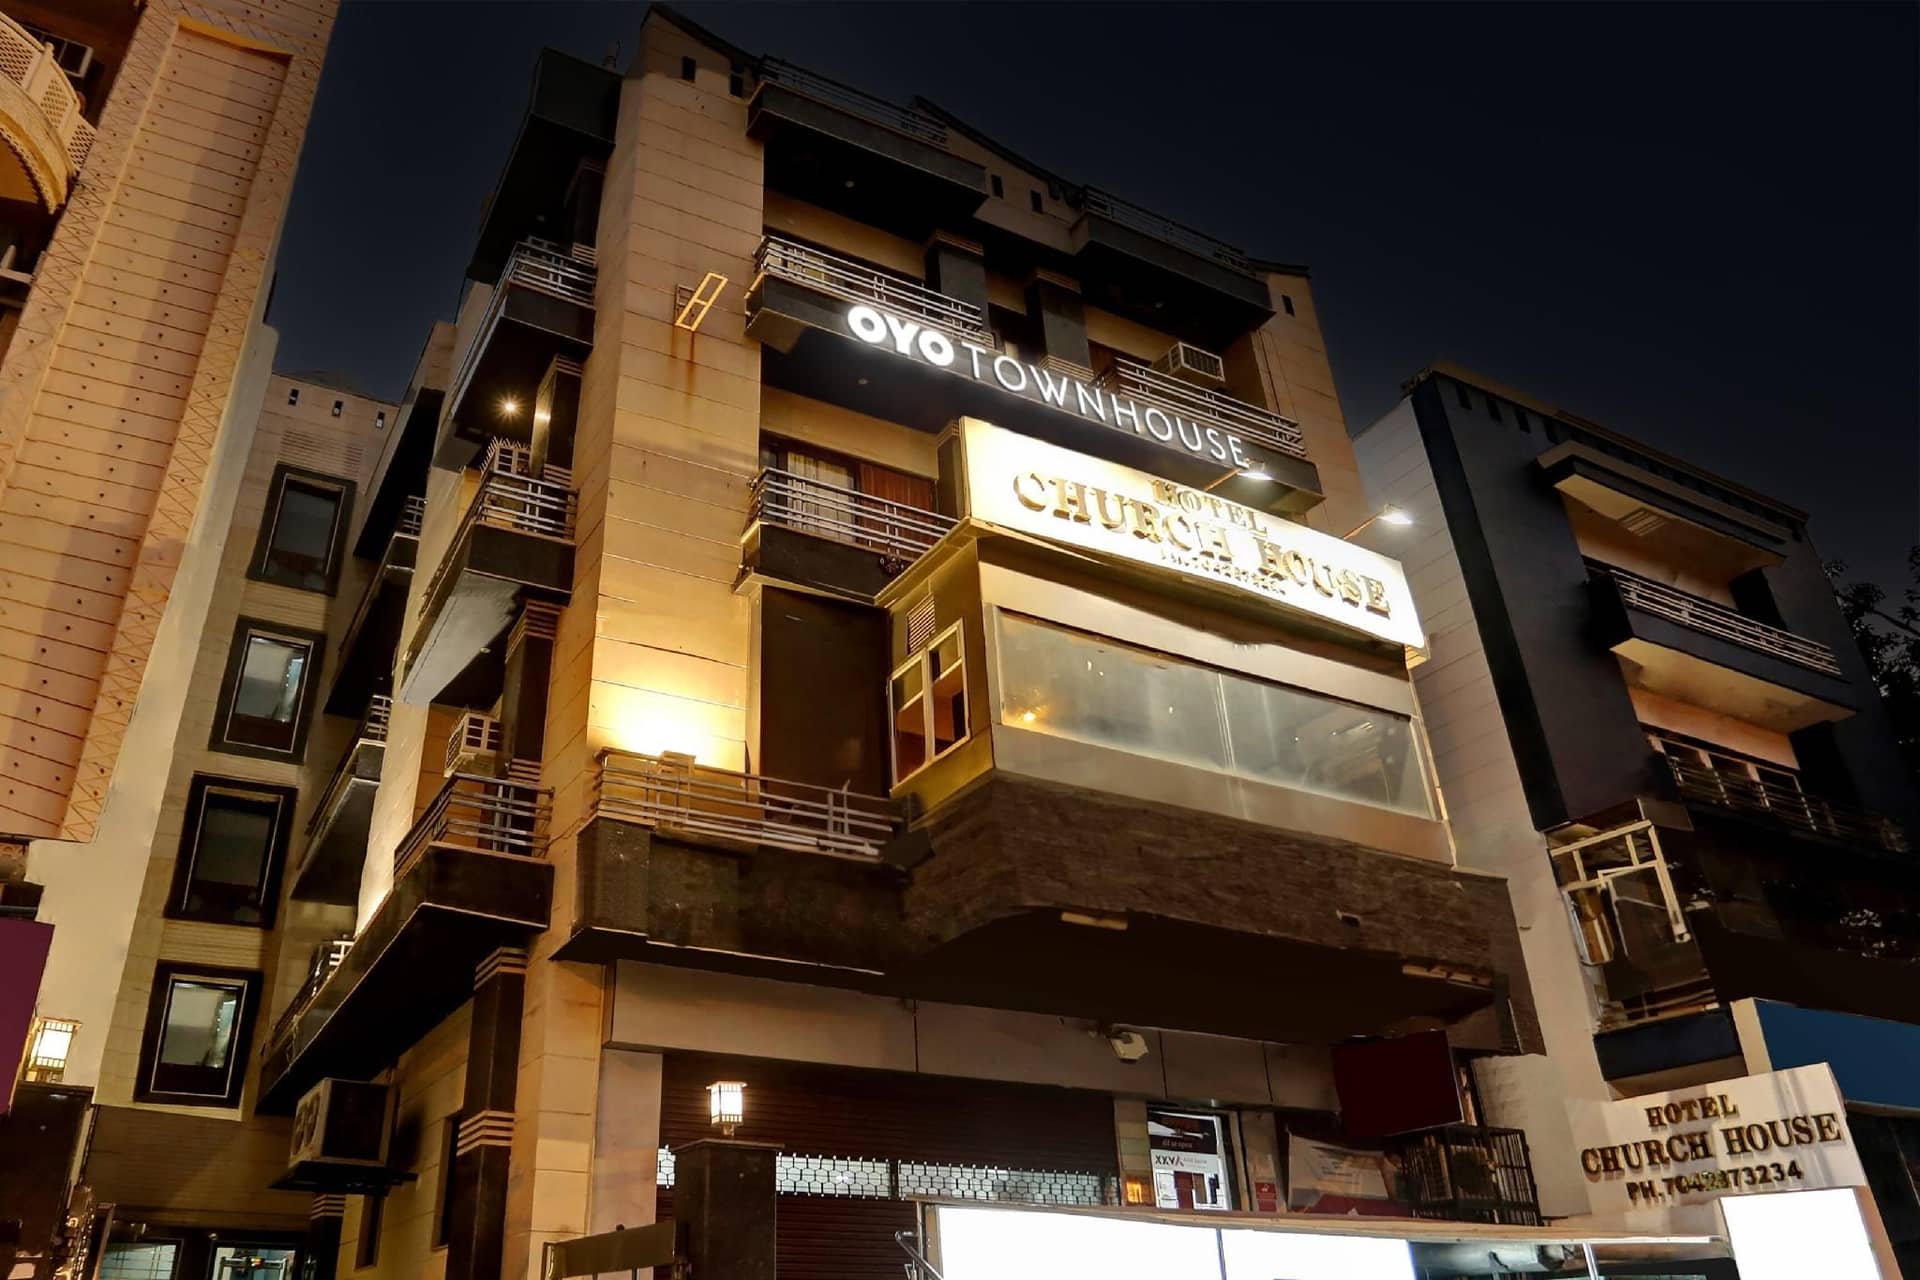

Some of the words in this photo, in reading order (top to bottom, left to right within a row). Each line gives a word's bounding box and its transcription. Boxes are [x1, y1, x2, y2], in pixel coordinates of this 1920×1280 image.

[847, 305, 955, 366] OYO
[961, 341, 1250, 467] TOWNHOUSE
[1148, 478, 1269, 537] HOTEL
[1012, 470, 1234, 561] CHURCH
[1253, 534, 1391, 618] HOUSE
[1644, 1094, 1739, 1128] HOTEL
[1580, 1130, 1713, 1176] CHURCH
[1720, 1112, 1842, 1156] HOUSE
